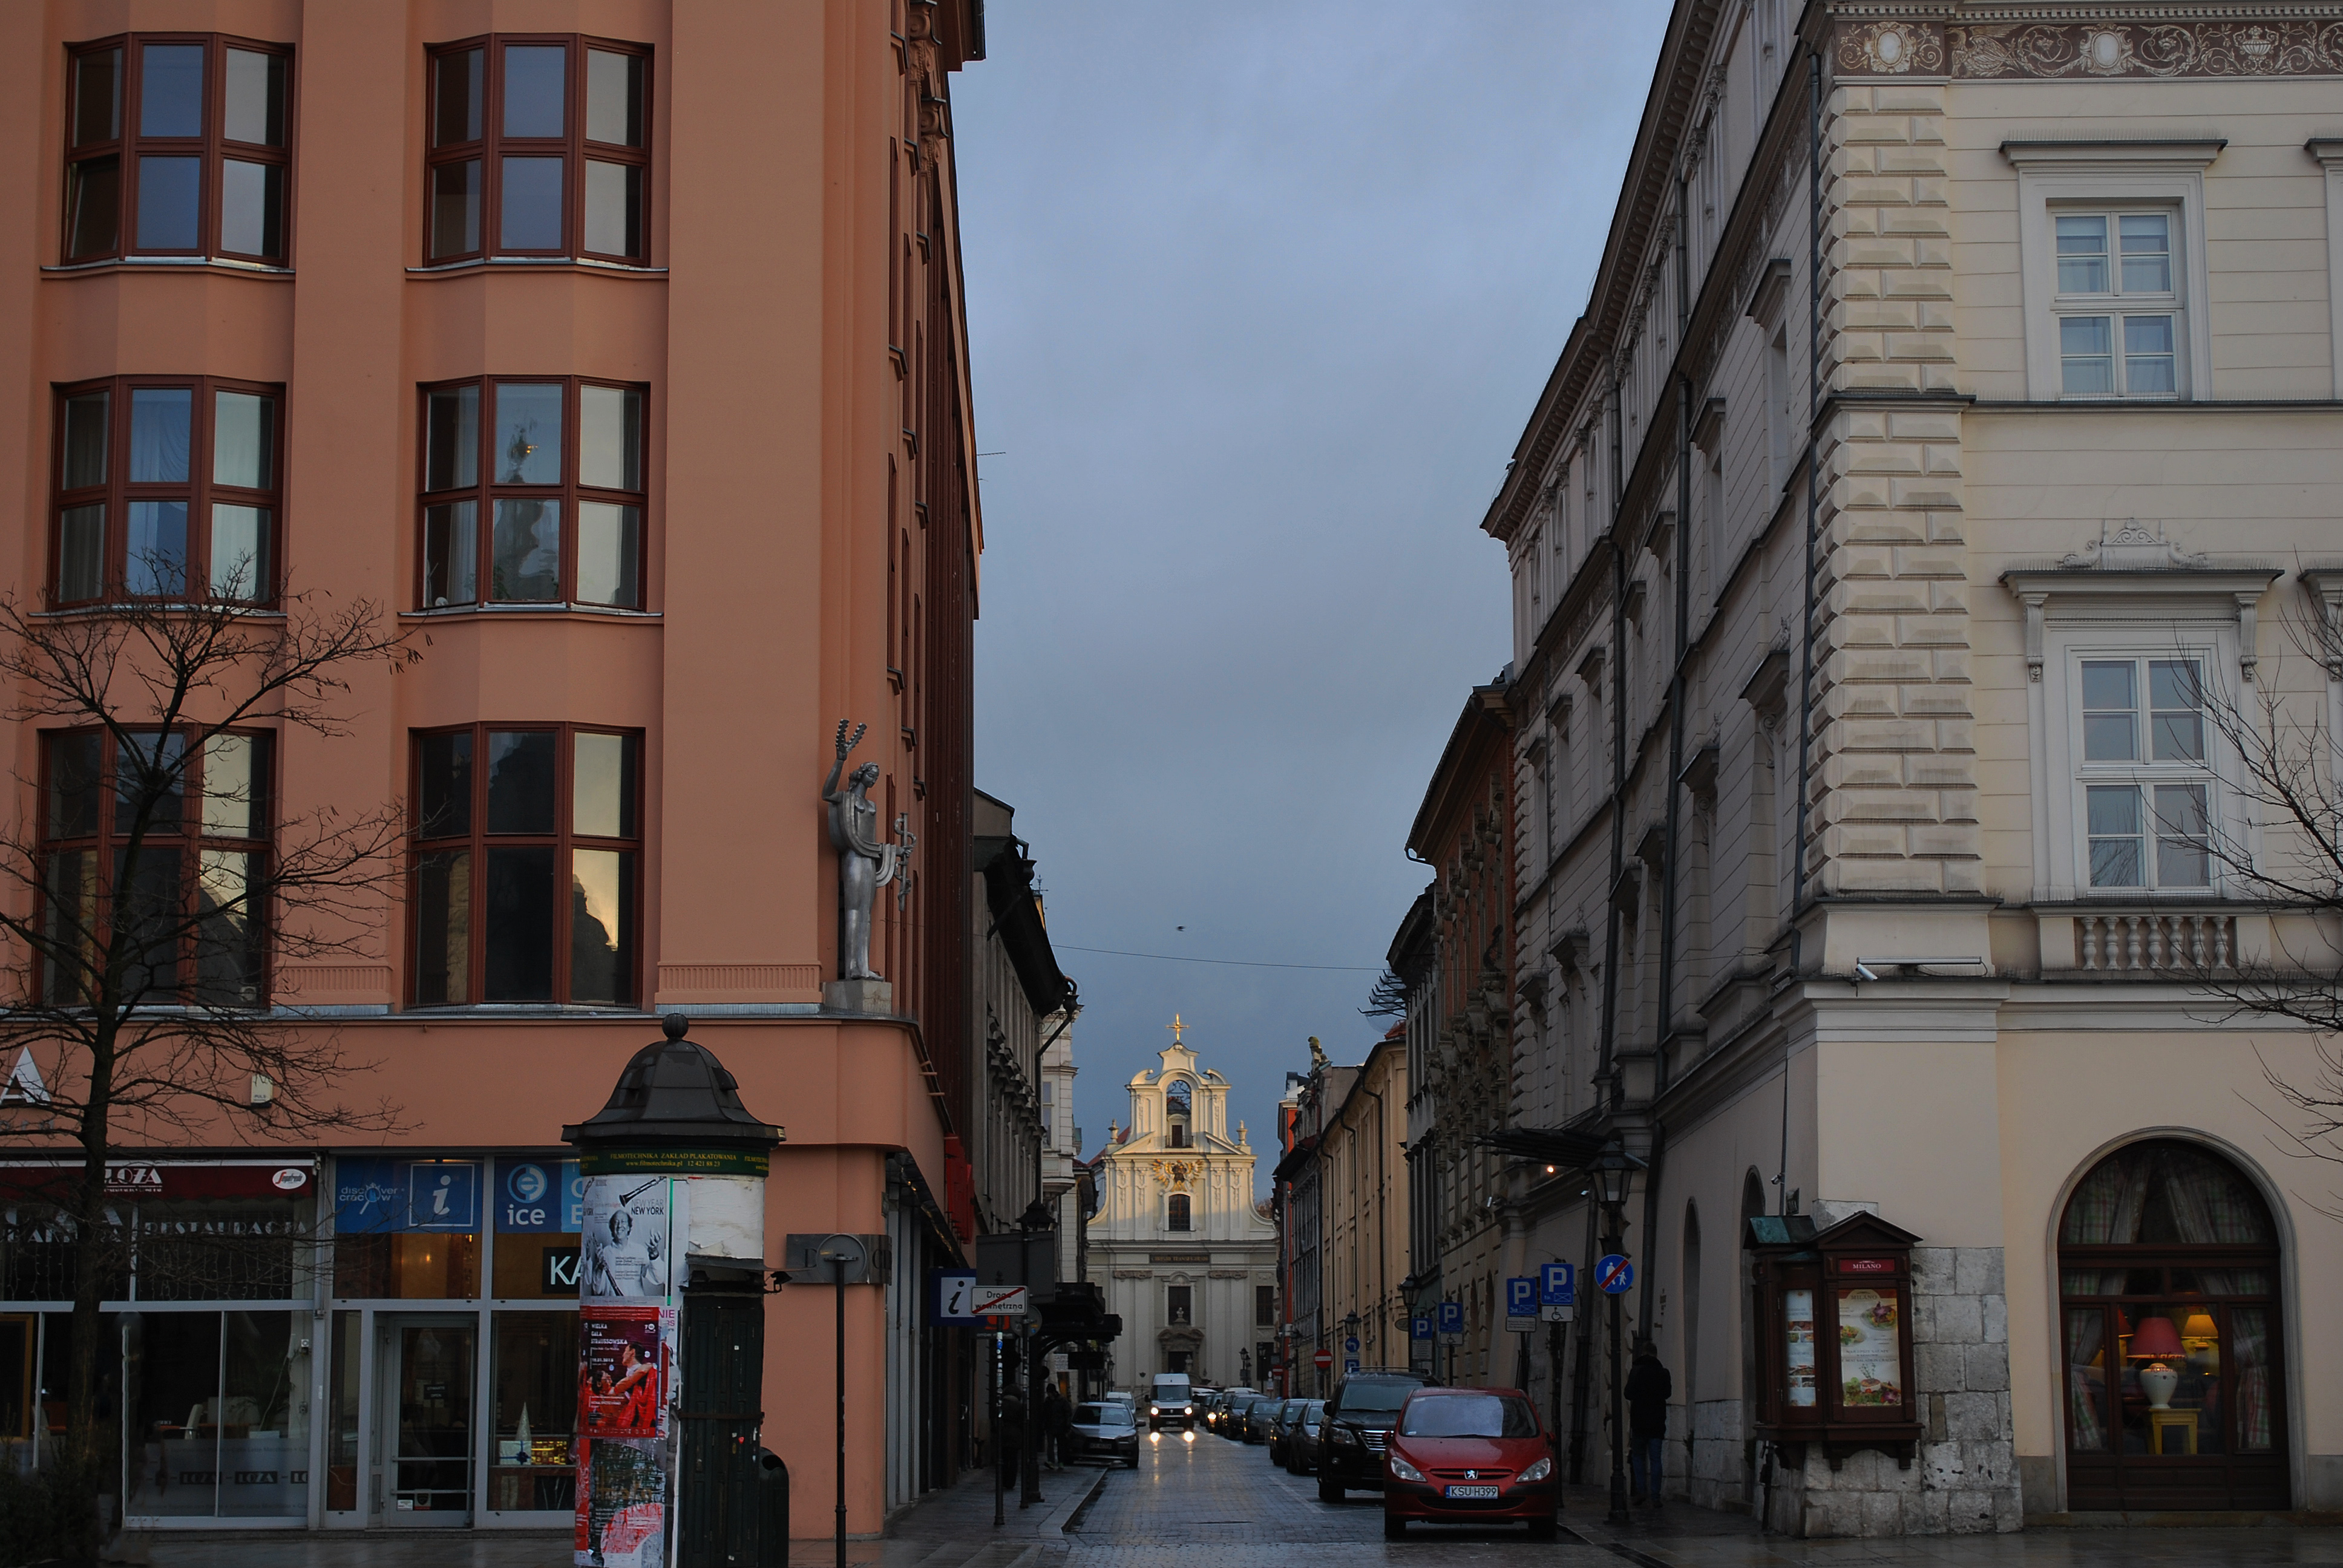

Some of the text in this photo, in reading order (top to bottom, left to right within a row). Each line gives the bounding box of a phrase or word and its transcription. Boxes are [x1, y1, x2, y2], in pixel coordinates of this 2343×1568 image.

[507, 1204, 545, 1226] ice
[1548, 1267, 1567, 1292] P
[1513, 1281, 1530, 1304] P
[1444, 1305, 1457, 1324] P
[1416, 1320, 1428, 1336] P
[1451, 1487, 1496, 1496] KSU H399
